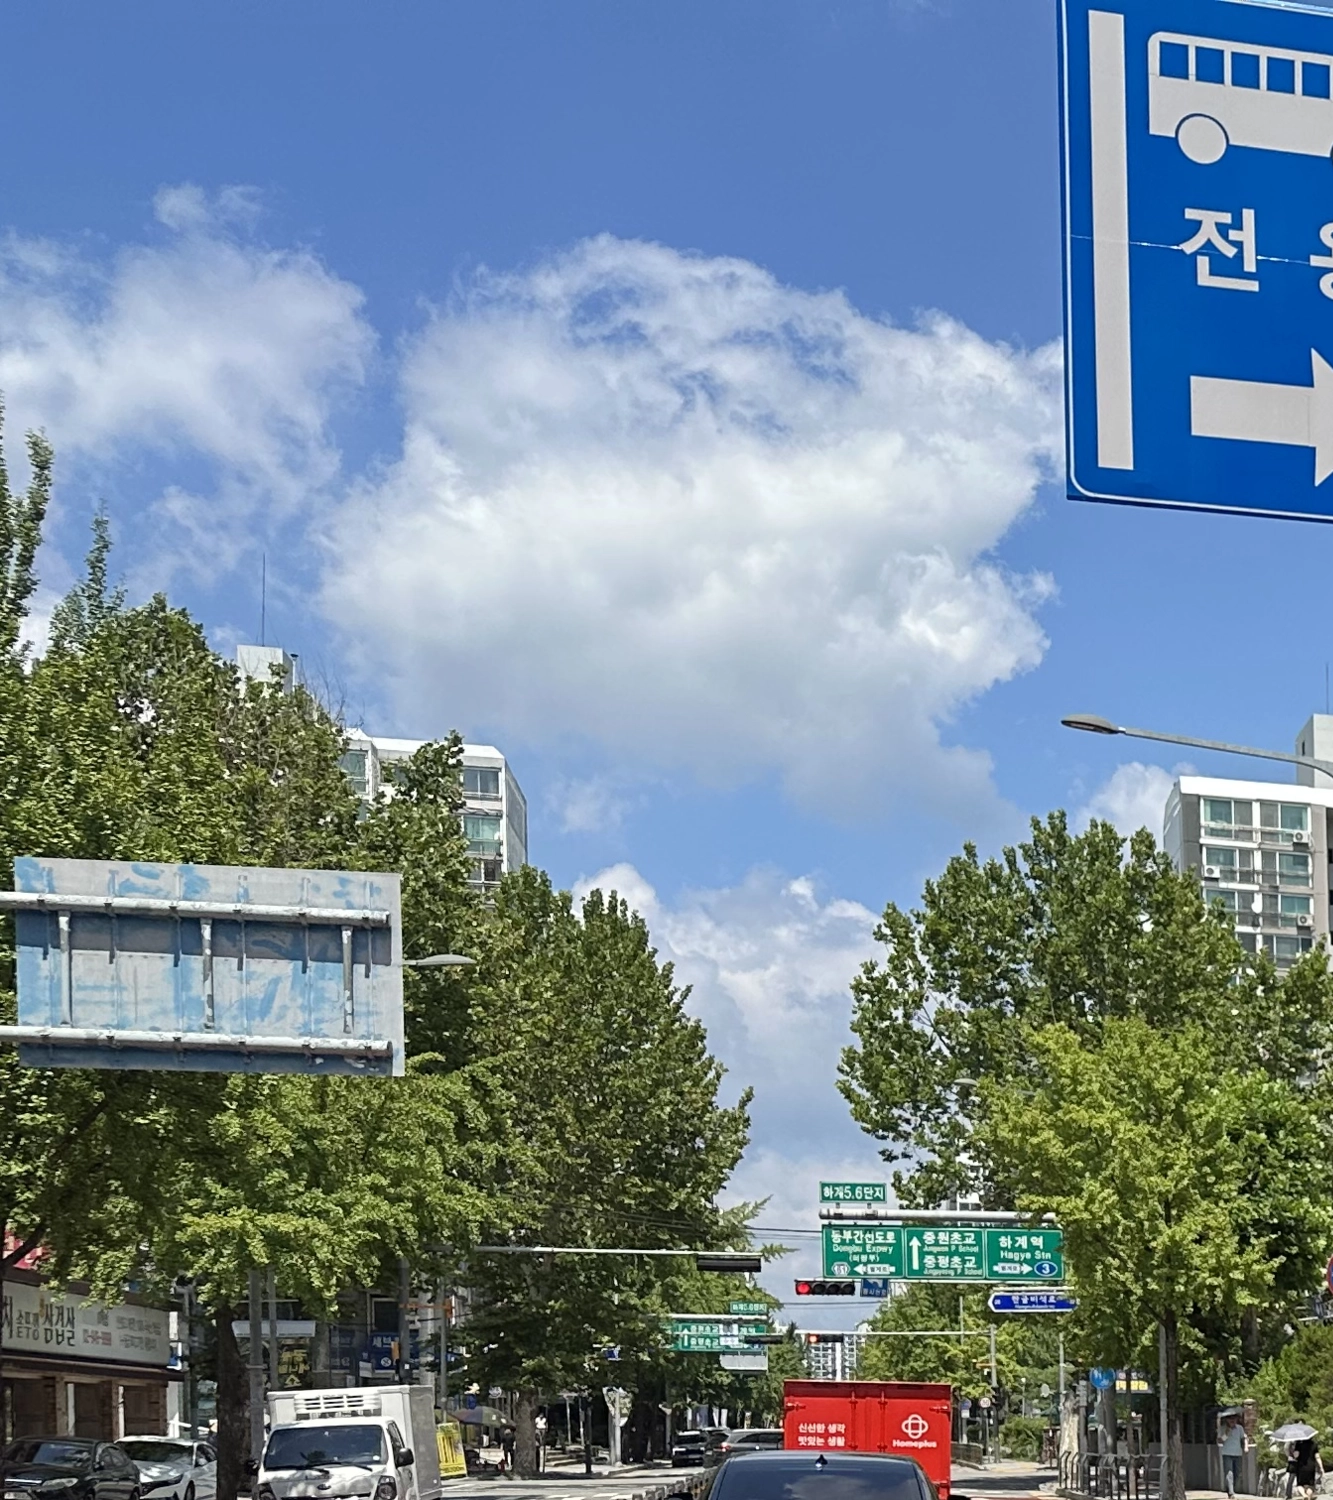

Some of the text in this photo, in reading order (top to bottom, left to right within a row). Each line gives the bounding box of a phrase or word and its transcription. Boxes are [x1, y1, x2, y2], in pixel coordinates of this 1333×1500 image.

[822, 1185, 884, 1200] 하계5.6단지
[831, 1229, 896, 1244] 동부간선도로
[998, 1235, 1043, 1250] 하계역
[1041, 1263, 1051, 1274] 3
[892, 1440, 937, 1449] Homeplus
